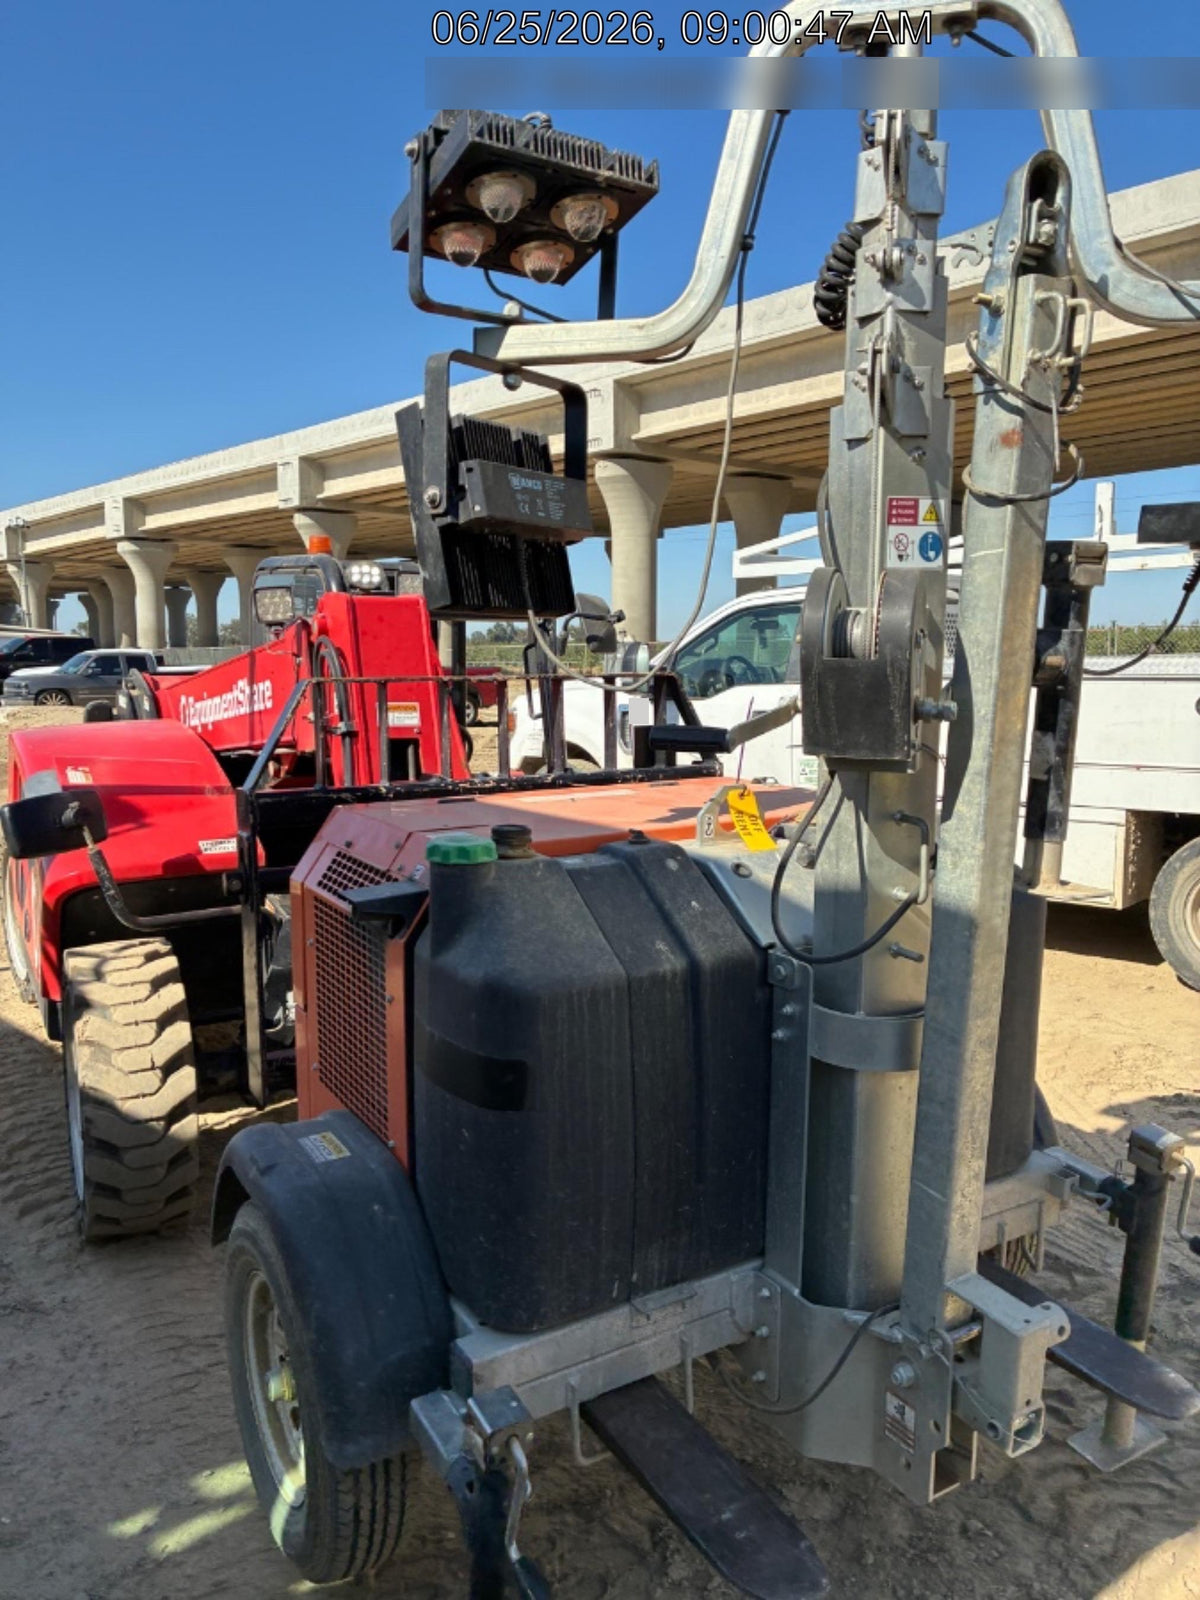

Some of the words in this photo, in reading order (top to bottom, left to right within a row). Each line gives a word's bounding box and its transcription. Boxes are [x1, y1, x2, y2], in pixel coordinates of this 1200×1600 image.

[188, 677, 273, 733] EquipmentShare
[734, 810, 753, 836] RENT
[748, 814, 764, 832] OFF
